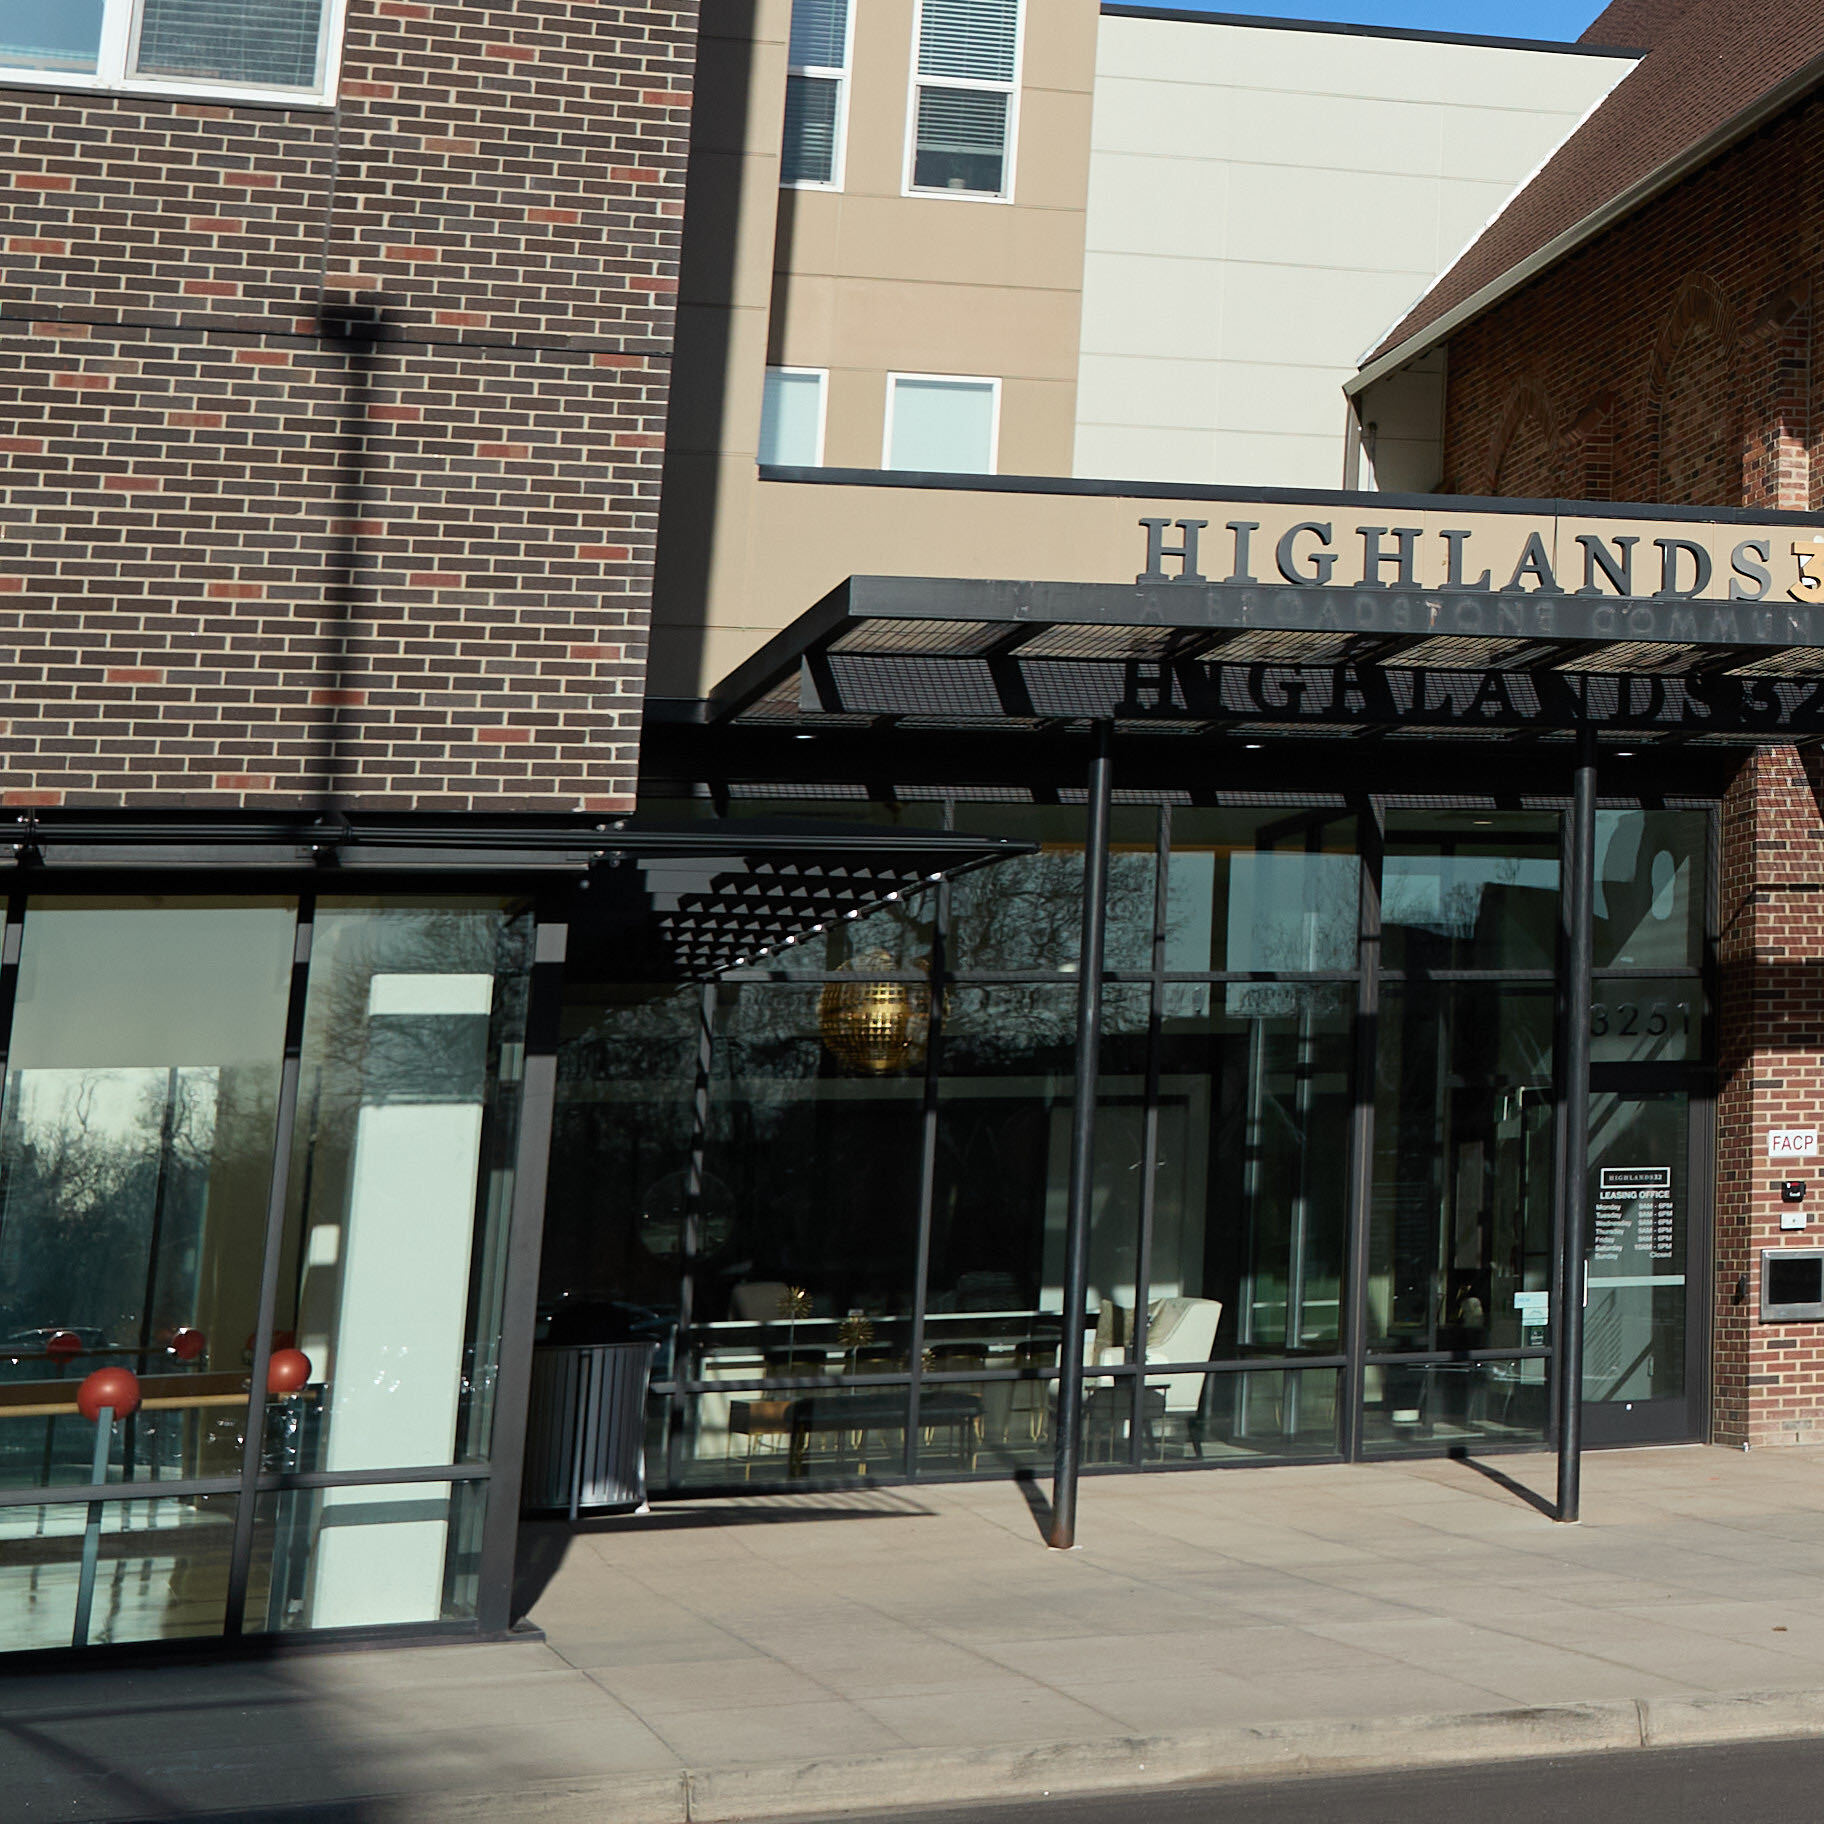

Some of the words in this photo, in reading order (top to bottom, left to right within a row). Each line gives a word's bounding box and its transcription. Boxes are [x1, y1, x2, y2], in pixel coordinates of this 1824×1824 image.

[1773, 1135, 1814, 1151] FACP
[1599, 1191, 1637, 1200] LEASING
[1638, 1190, 1671, 1199] OFFICE
